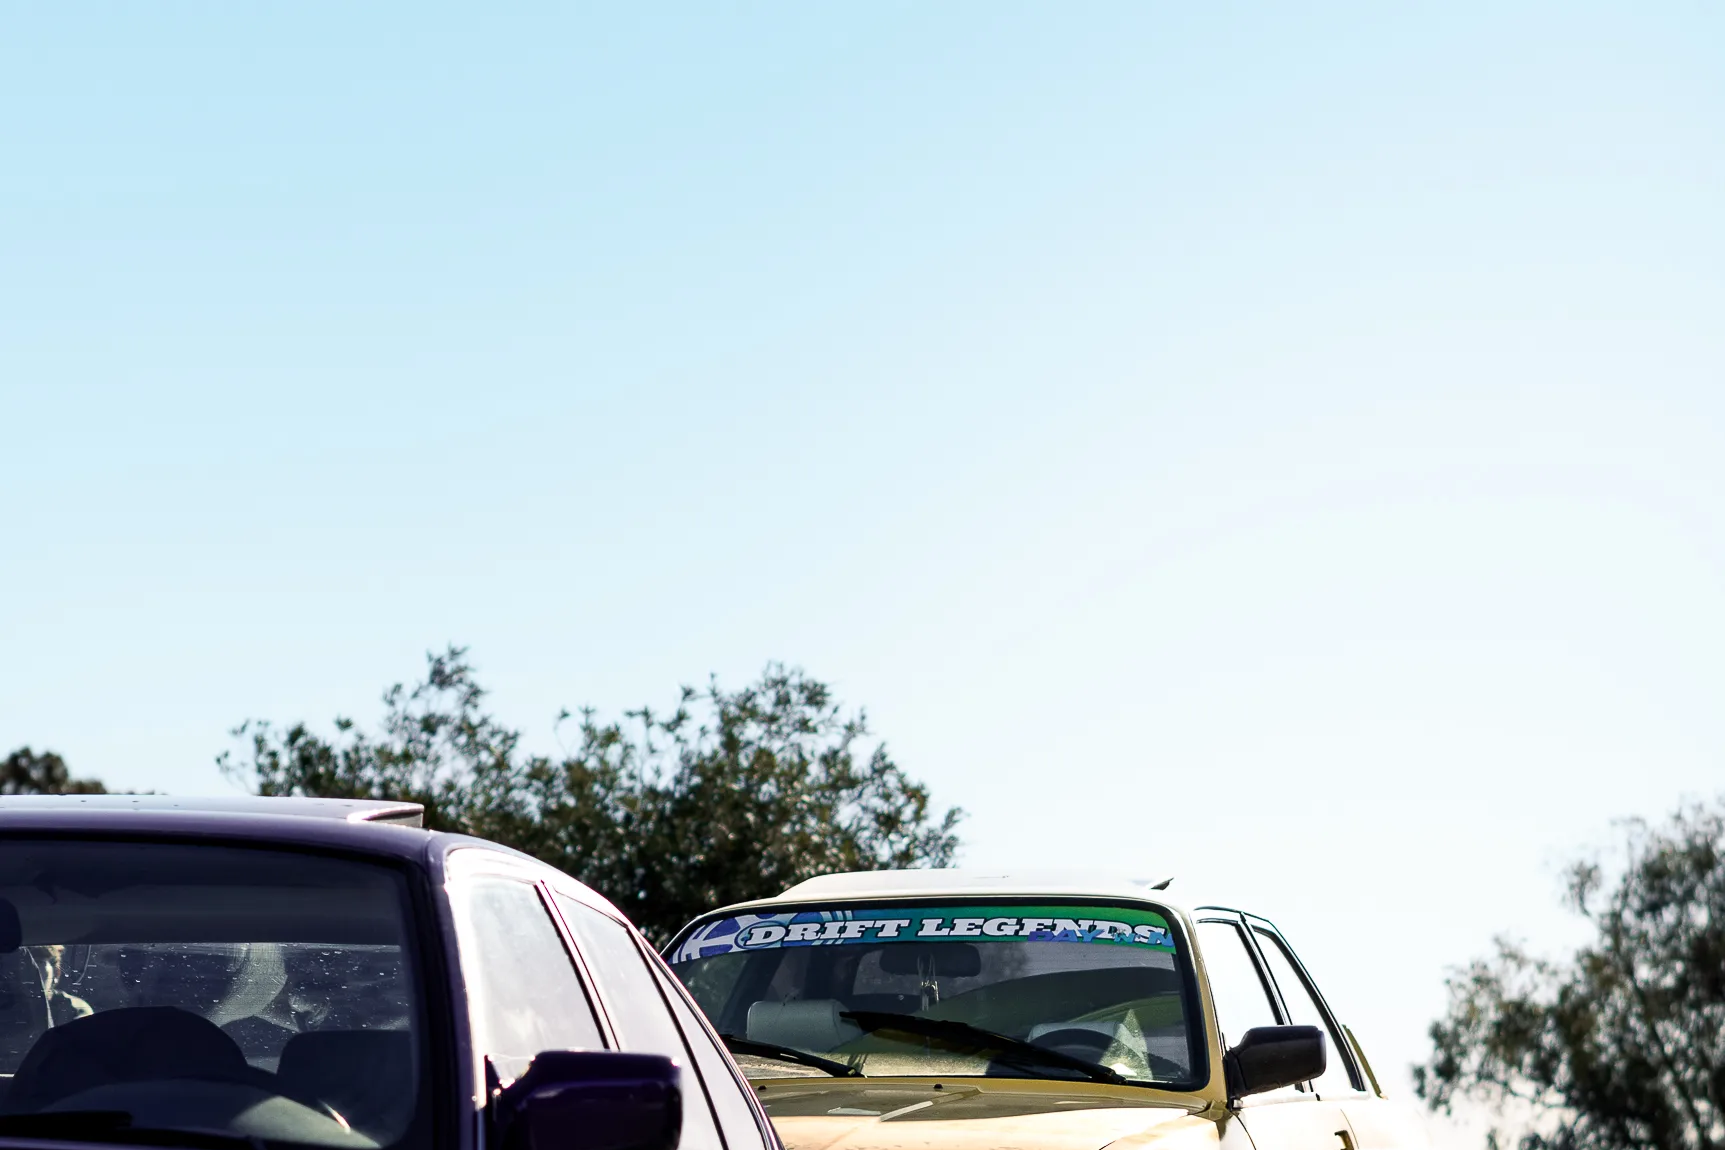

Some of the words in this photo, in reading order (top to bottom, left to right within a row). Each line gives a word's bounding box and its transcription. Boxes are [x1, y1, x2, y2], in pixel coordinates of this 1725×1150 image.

[744, 918, 911, 946] DRIFT
[917, 916, 1168, 944] LEGENDS
[1027, 928, 1105, 942] DAY
